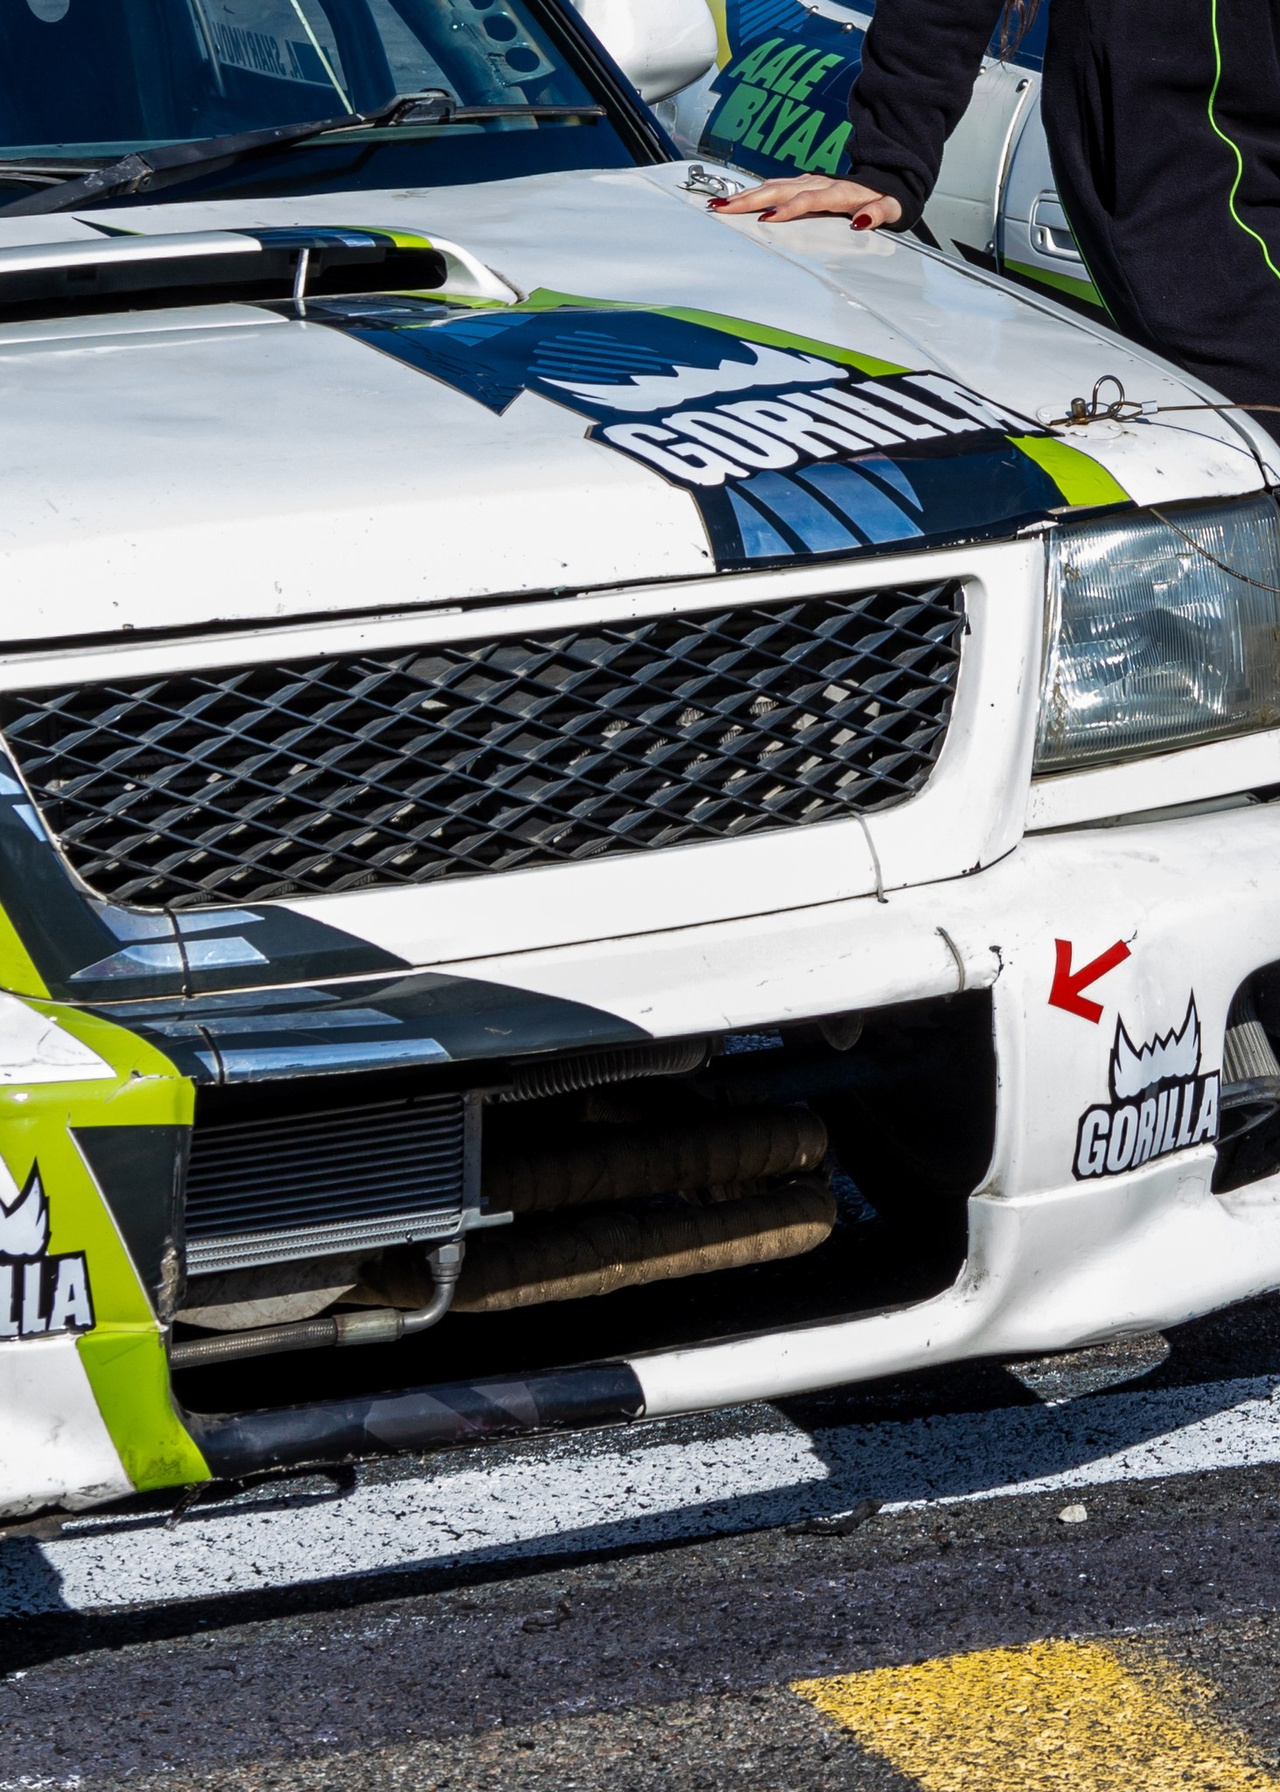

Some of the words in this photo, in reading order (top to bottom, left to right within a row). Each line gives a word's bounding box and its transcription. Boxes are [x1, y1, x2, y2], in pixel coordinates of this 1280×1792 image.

[729, 37, 845, 101] AALE
[711, 82, 854, 175] BLYAA
[603, 373, 1046, 486] GORILLA
[1076, 1074, 1220, 1176] GORILLA
